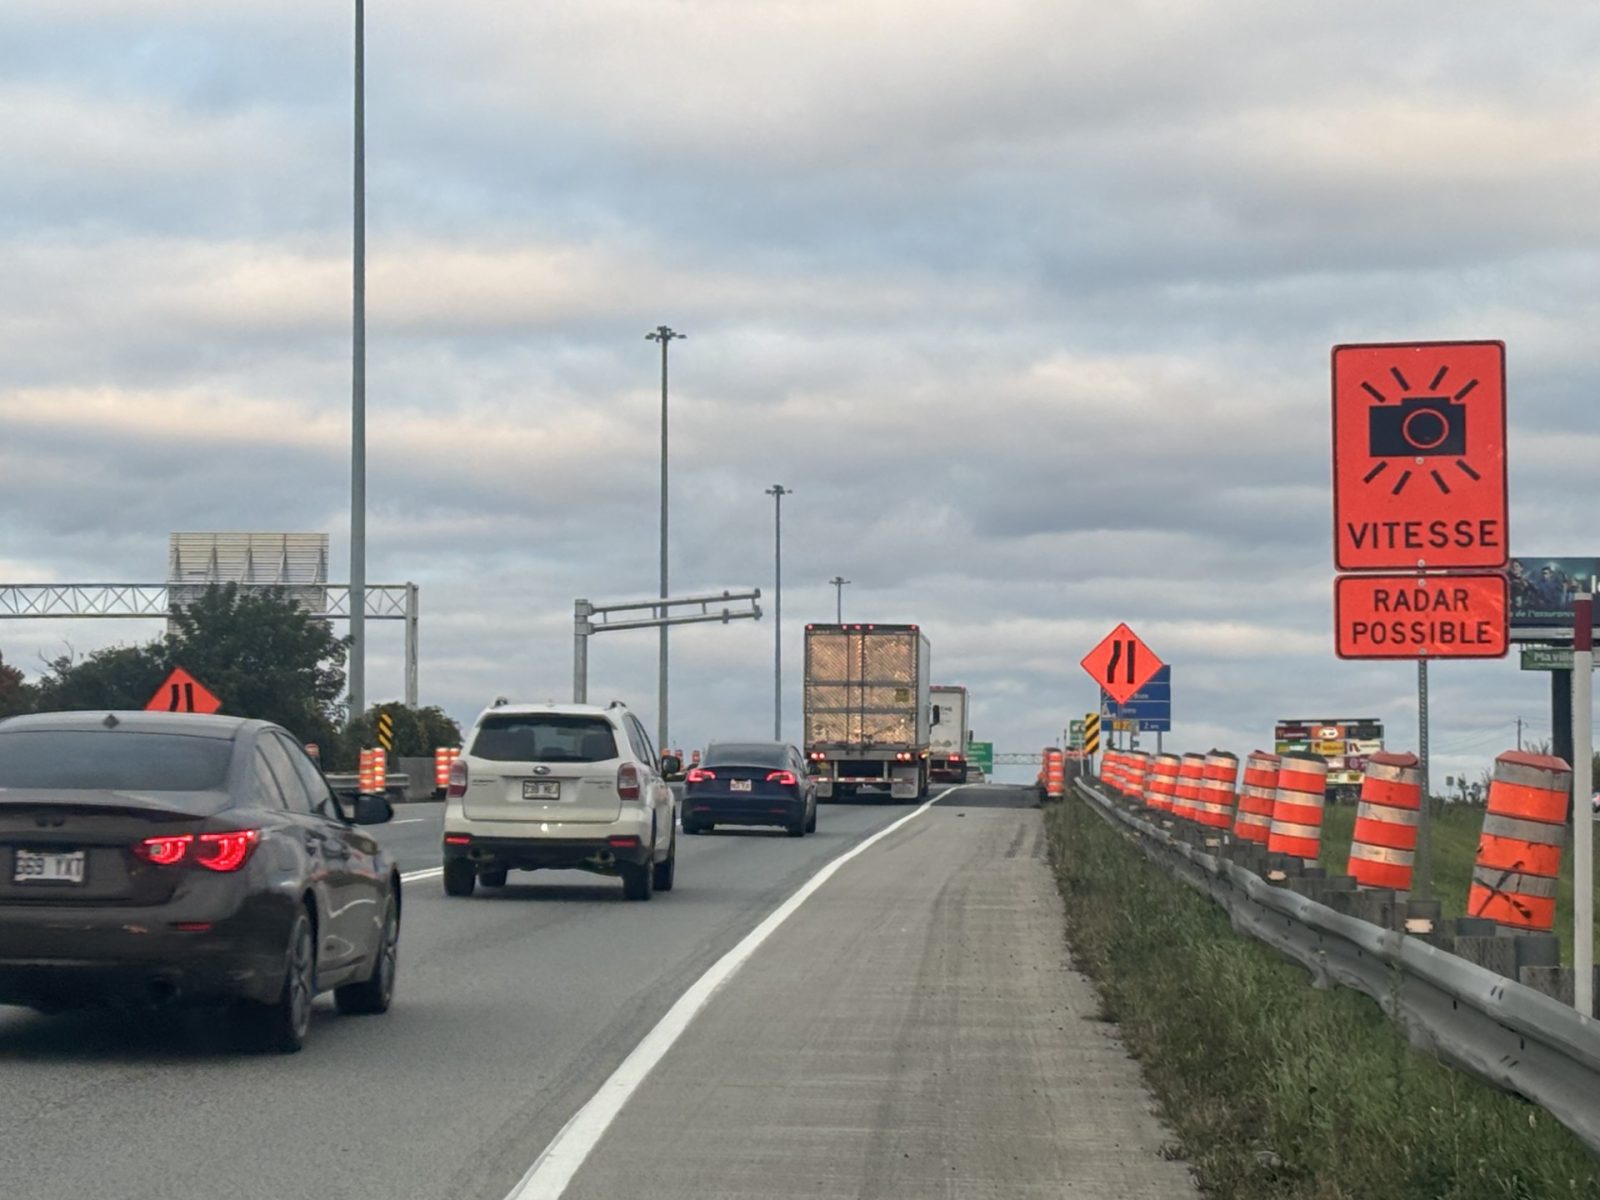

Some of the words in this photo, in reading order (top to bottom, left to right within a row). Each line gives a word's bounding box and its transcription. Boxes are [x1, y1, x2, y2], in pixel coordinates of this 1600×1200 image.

[1347, 520, 1499, 549] VITESSE
[1374, 589, 1470, 612] RADAR
[1352, 621, 1493, 645] POSSIBLE
